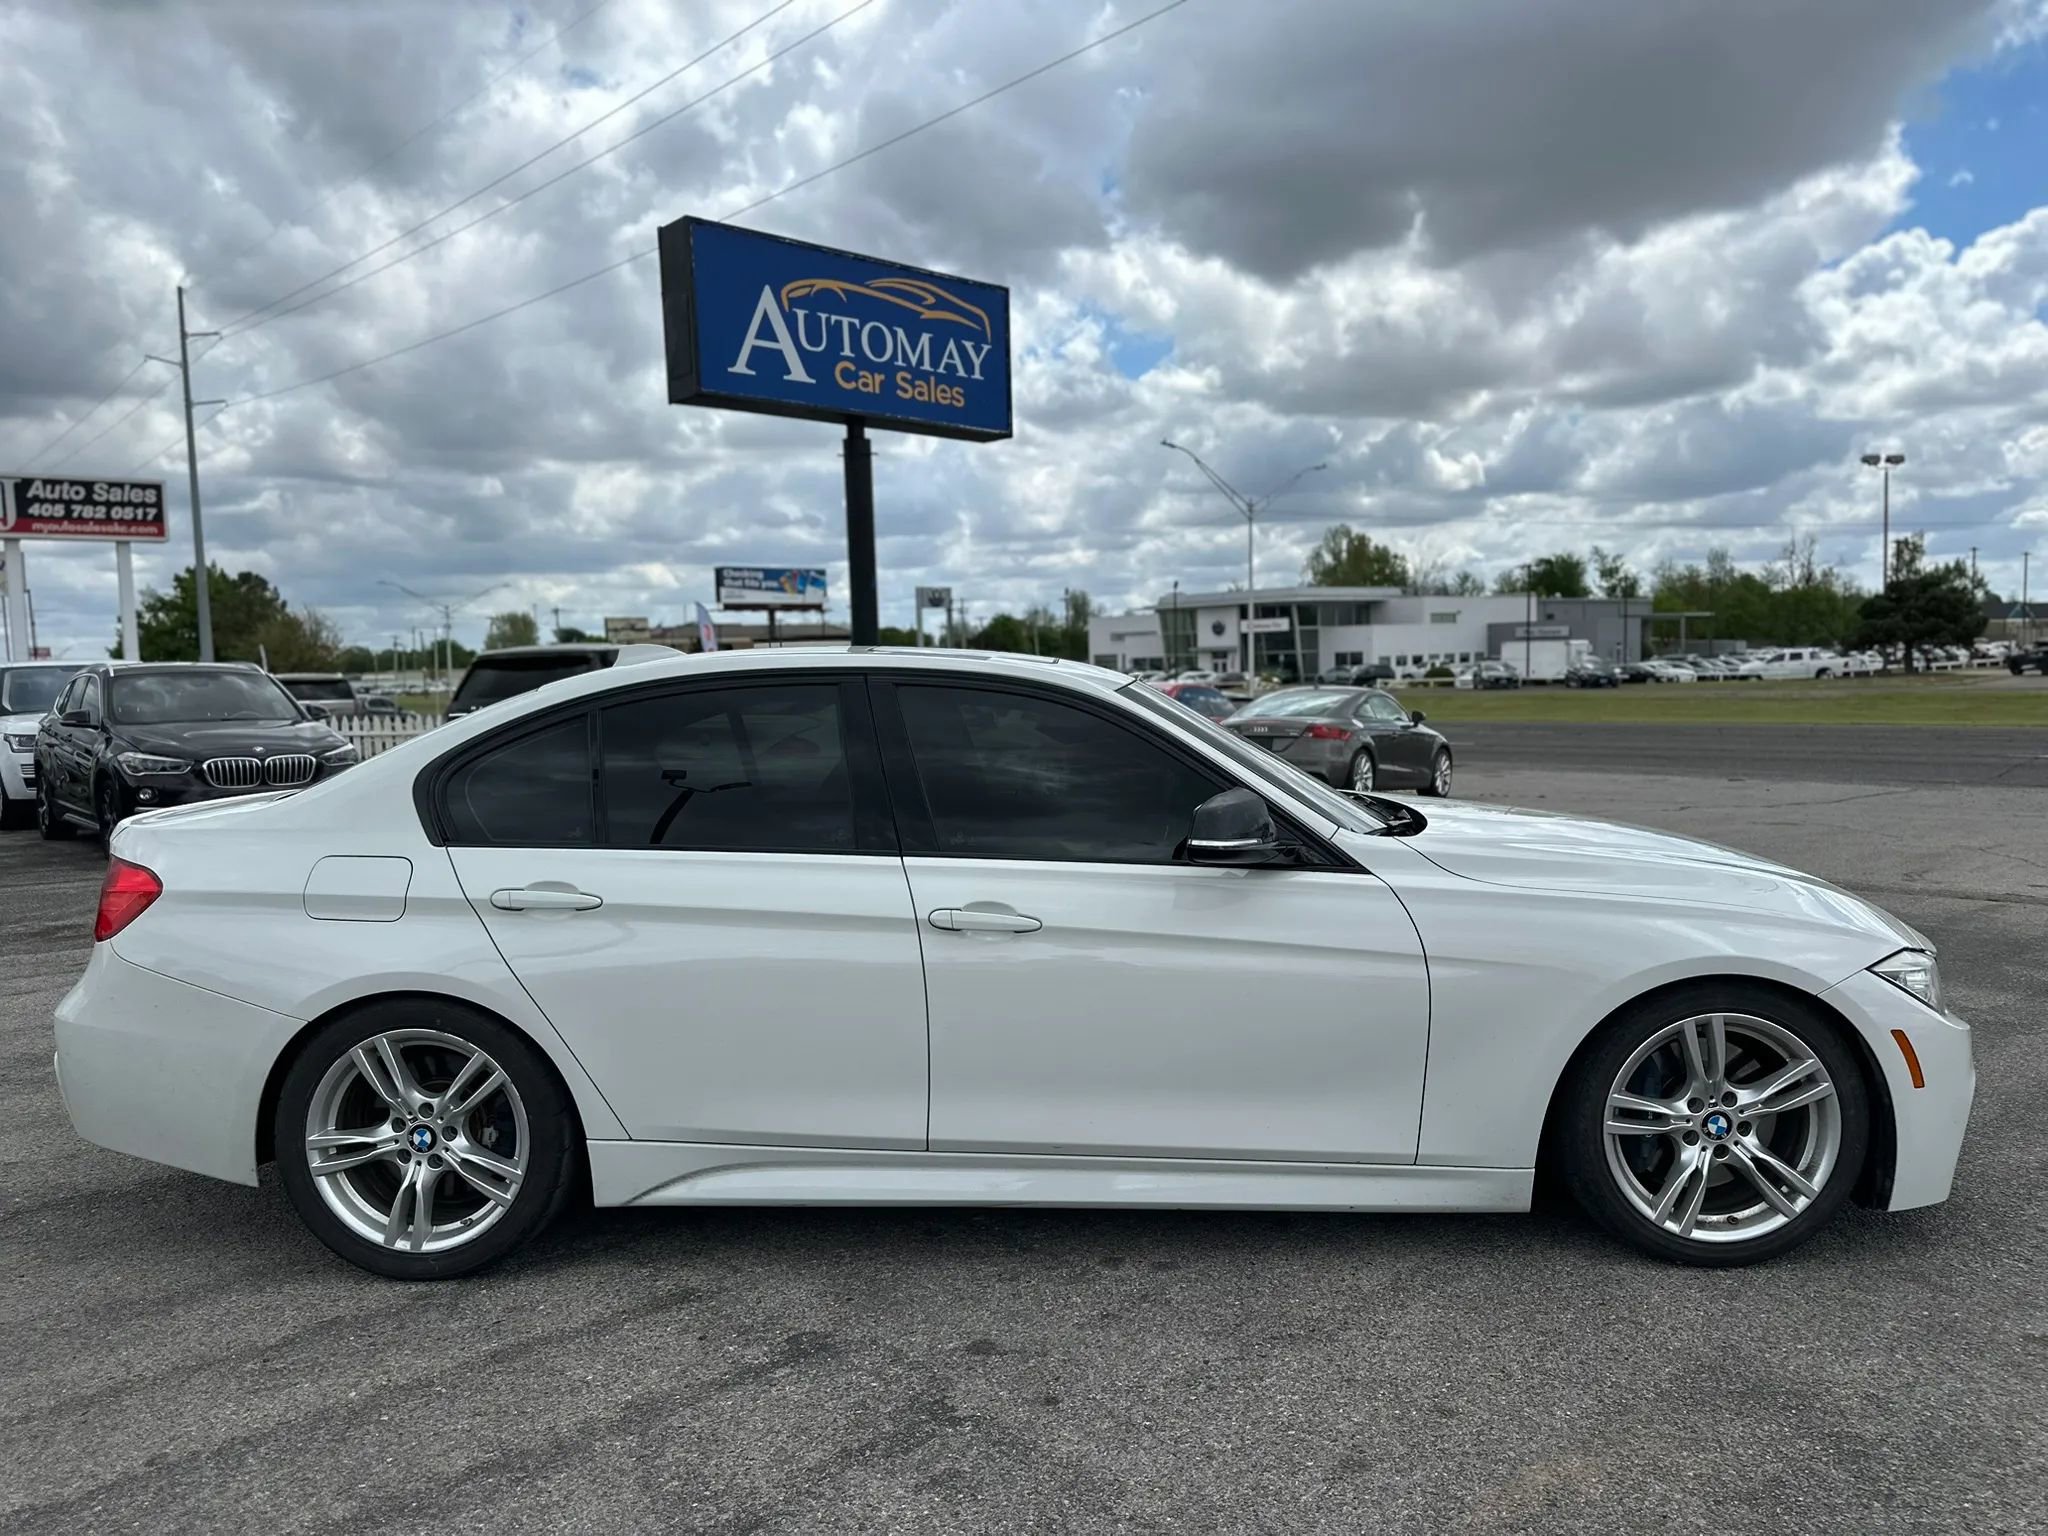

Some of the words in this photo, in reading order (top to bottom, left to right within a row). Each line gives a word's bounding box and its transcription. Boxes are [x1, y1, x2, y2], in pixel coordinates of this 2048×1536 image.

[727, 284, 992, 384] AUTOMAY
[834, 361, 885, 395] Car
[895, 372, 966, 408] Sales
[26, 479, 87, 501] Auto
[92, 483, 158, 504] Sales
[28, 502, 65, 518] 405
[71, 504, 106, 519] 782
[110, 506, 158, 521] 0517
